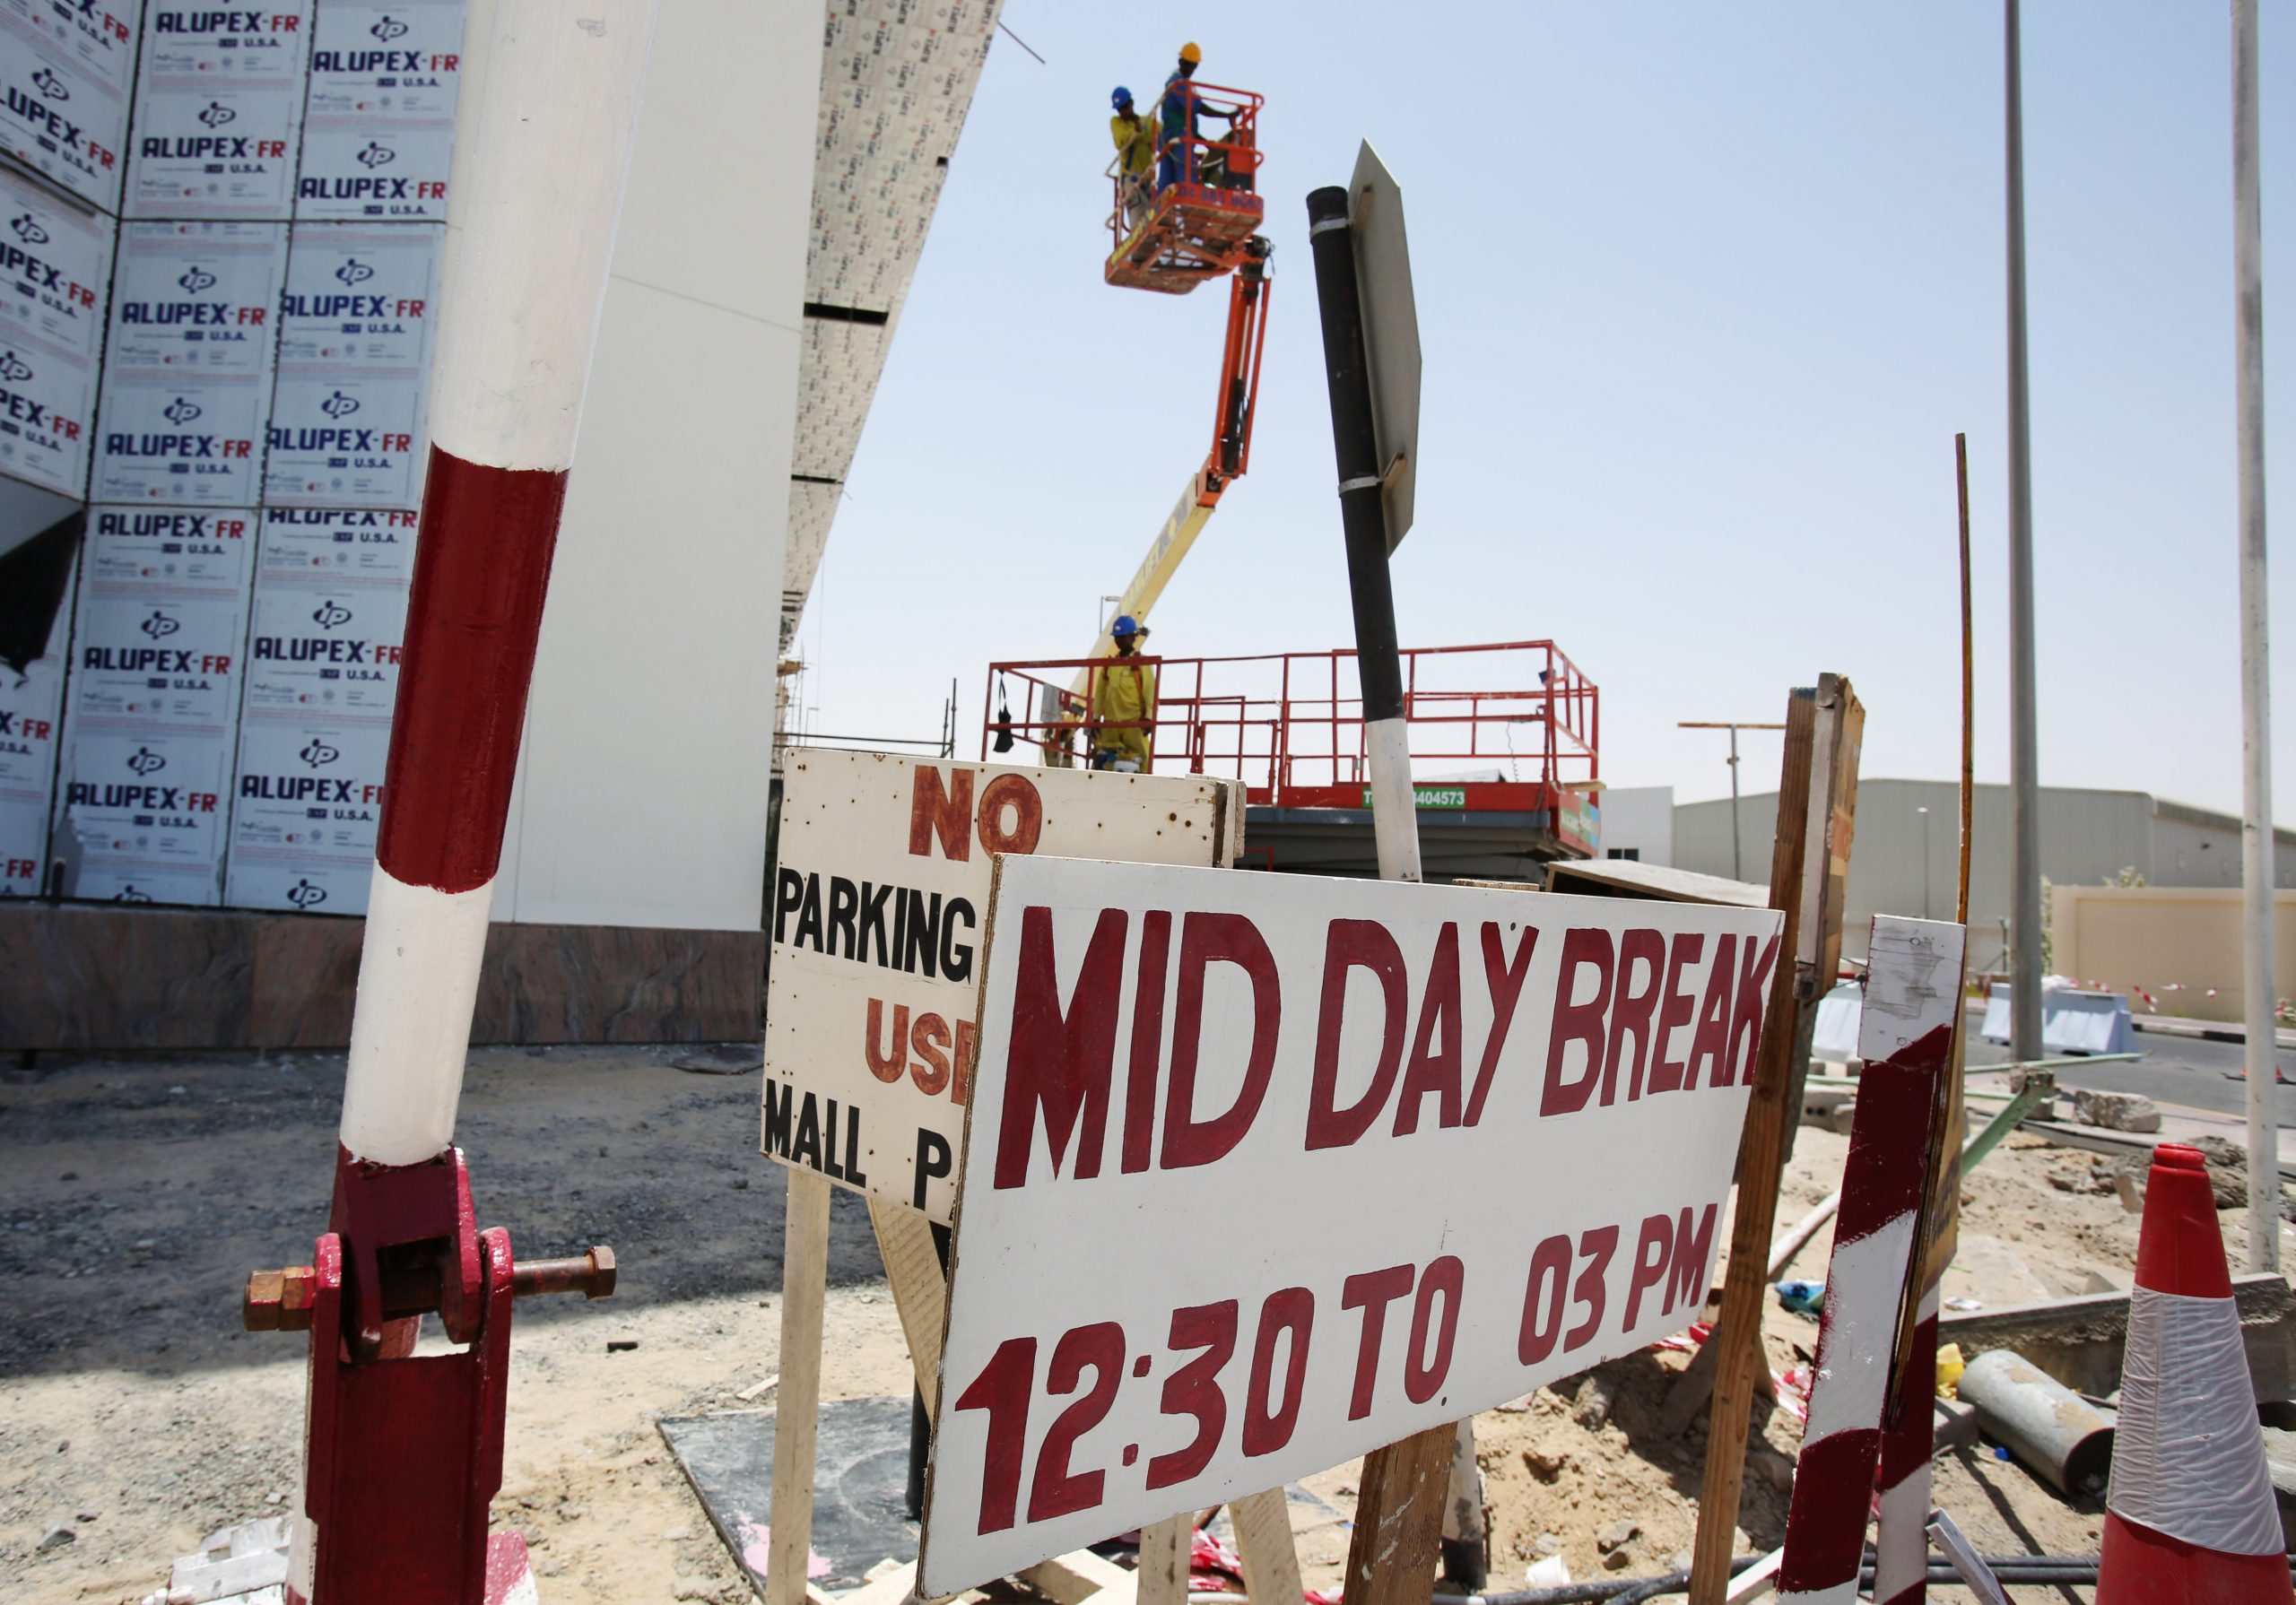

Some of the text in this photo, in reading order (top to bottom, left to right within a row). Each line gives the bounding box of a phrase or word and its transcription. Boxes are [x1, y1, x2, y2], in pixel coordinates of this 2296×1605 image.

[156, 12, 300, 33] ALUPEX-FR
[313, 51, 460, 72] ALUPEX-FR
[142, 137, 285, 159] ALUPEX-FR
[300, 178, 448, 199] ALUPEX-FR
[122, 302, 266, 325] ALUPEX-FR
[283, 295, 425, 317] ALUPEX-FR
[107, 433, 251, 458] ALUPEX-FR
[267, 428, 412, 452] ALUPEX-FR
[99, 513, 245, 538] ALUPEX-FR
[84, 646, 230, 674] ALUPEX-FR
[68, 783, 217, 812] ALUPEX-FR
[909, 764, 1042, 862] NO
[774, 867, 976, 985] PARKING
[994, 907, 1780, 1190] MID DAY BREAK
[764, 1078, 866, 1189] MALL
[955, 1203, 1718, 1537] 12:30 TO 03 PM
